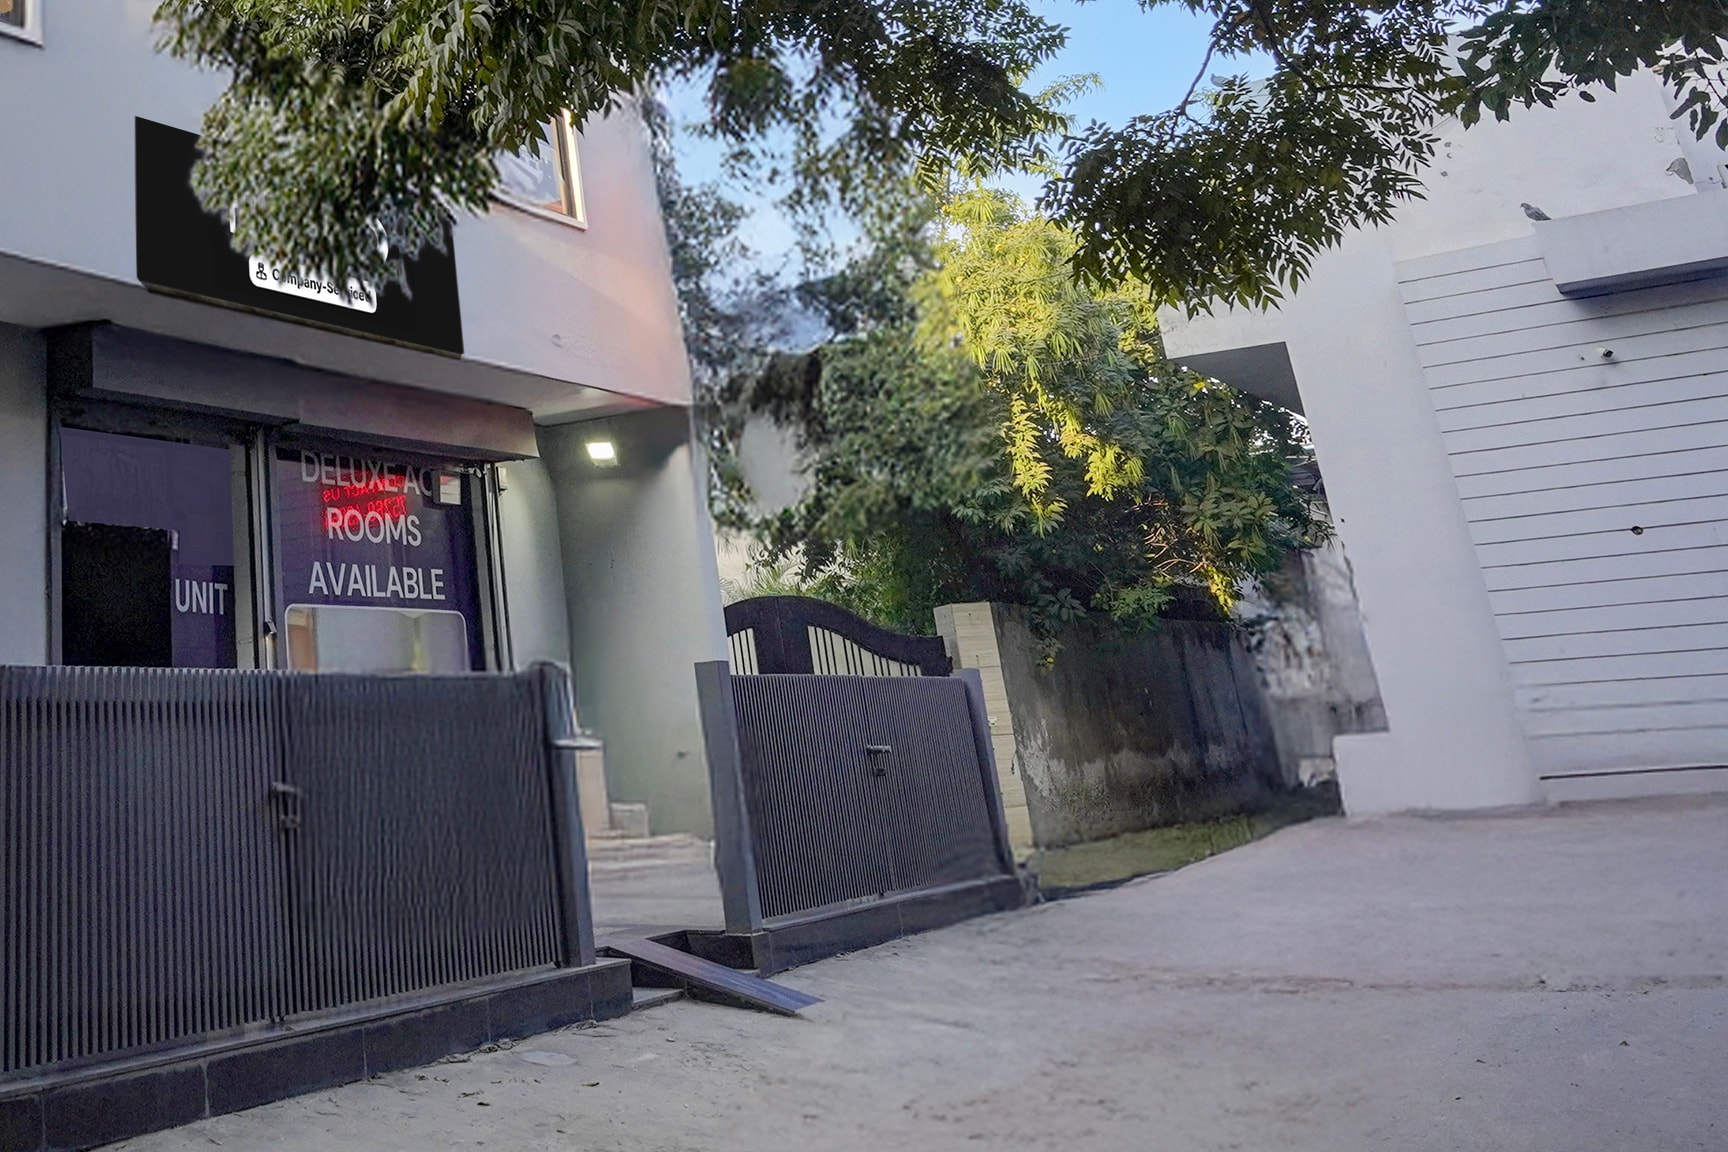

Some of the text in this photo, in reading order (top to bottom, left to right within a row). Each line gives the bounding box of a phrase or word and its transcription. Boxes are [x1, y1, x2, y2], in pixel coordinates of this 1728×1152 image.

[272, 268, 371, 303] Cmpany-Seiced
[301, 449, 399, 492] DELUXE
[326, 506, 422, 547] ROOMS
[175, 577, 228, 615] UNIT
[308, 561, 446, 601] AVAILABLE
